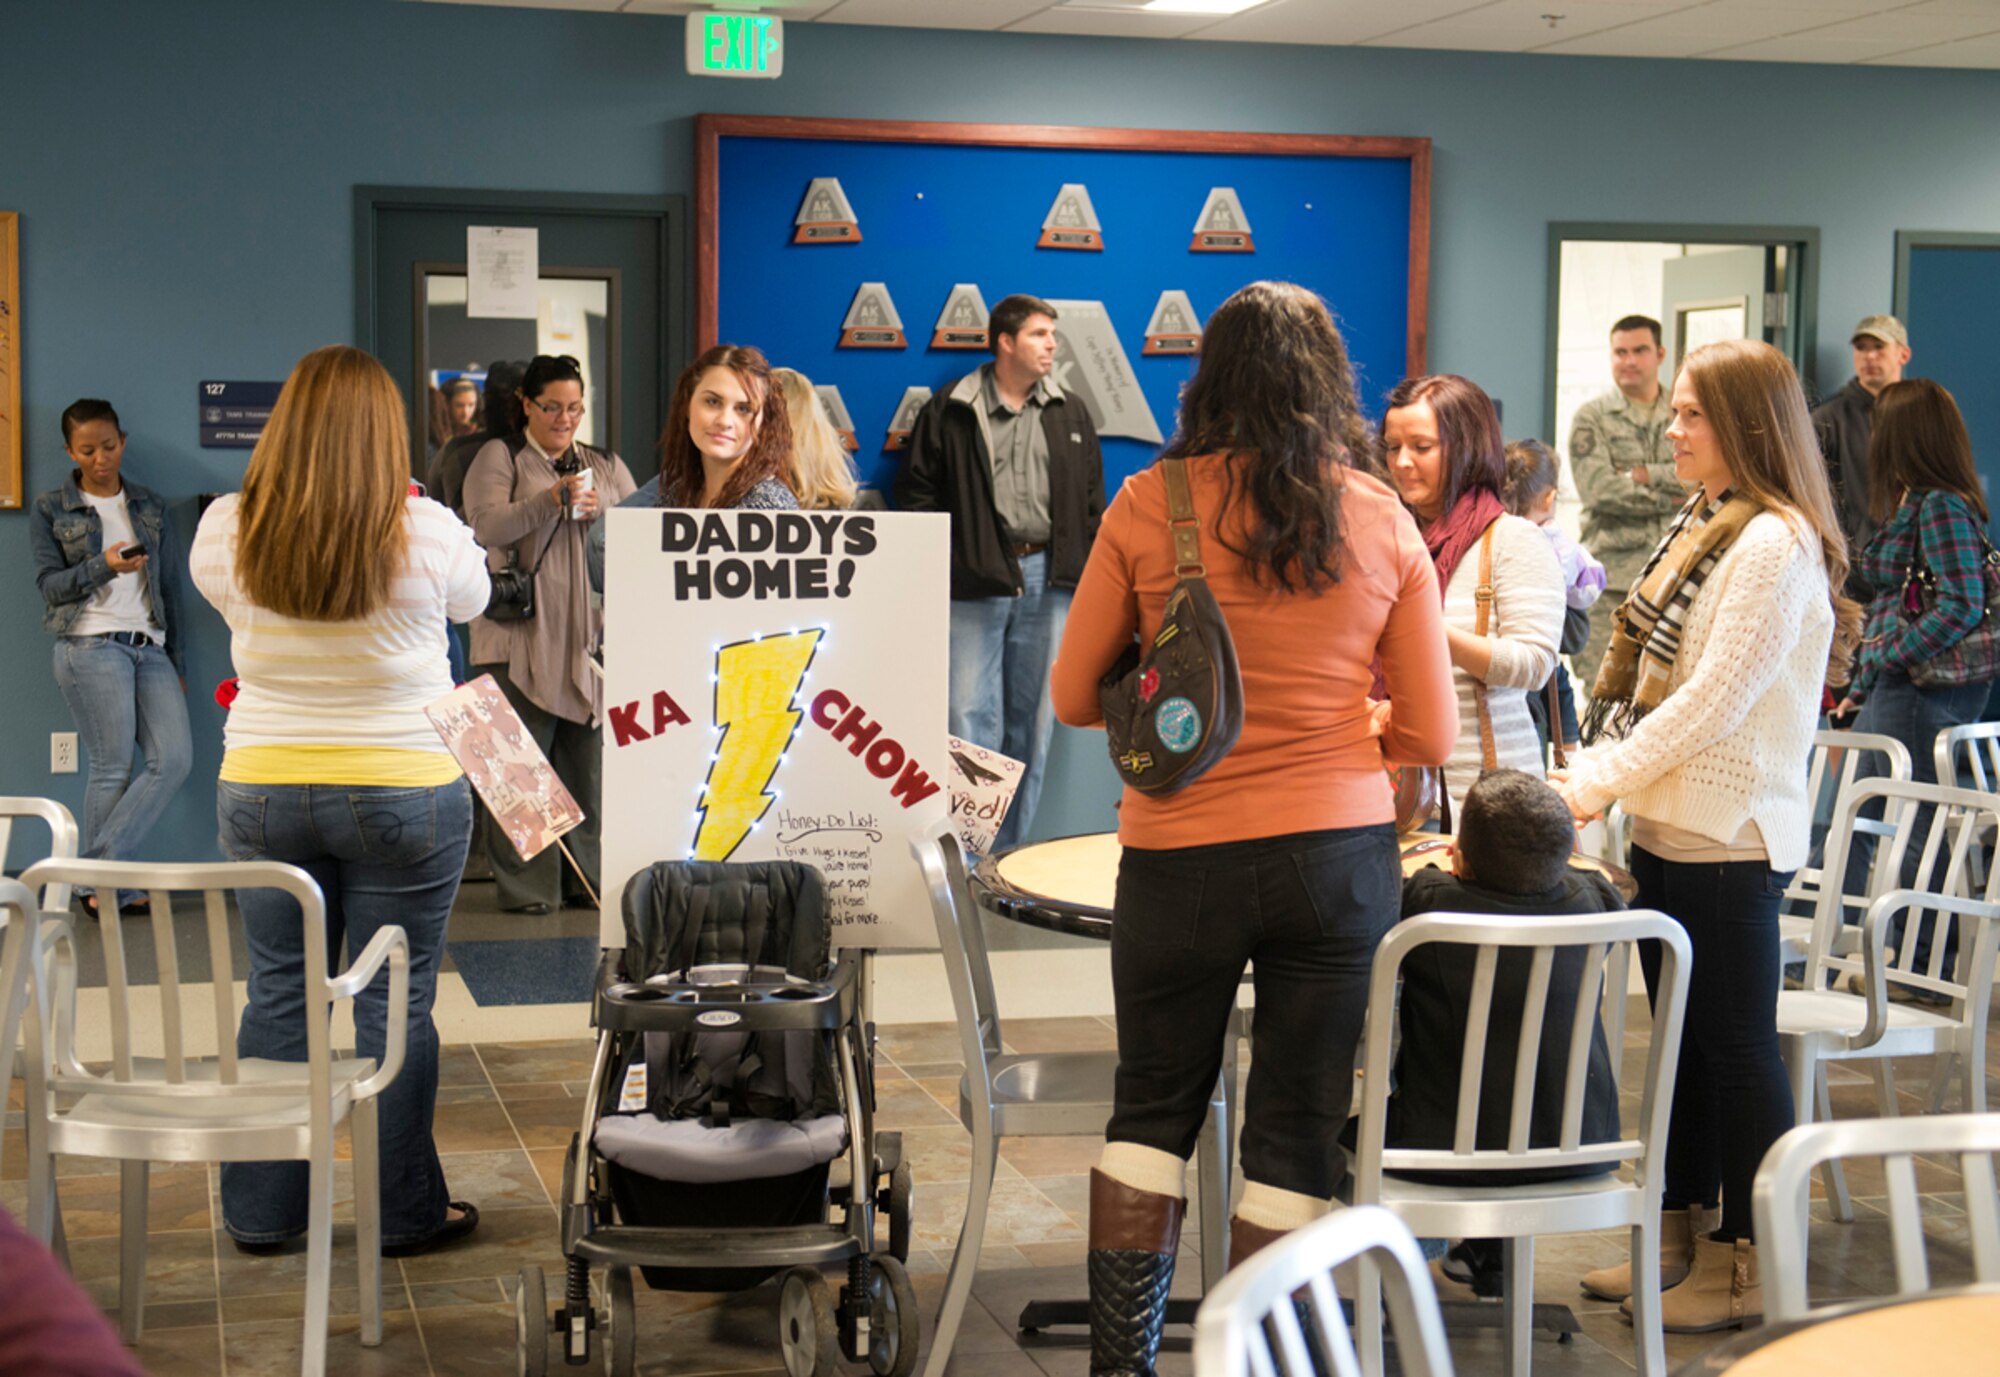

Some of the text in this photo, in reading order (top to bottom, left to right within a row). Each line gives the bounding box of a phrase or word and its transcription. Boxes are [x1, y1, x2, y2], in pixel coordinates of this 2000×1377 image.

[704, 15, 773, 72] EXIT
[813, 200, 830, 212] AK
[1060, 203, 1078, 216] AK
[1213, 210, 1231, 220] AK
[860, 305, 879, 317] AK
[954, 306, 973, 318] AK
[1163, 312, 1181, 323] AK
[205, 383, 226, 395] 127
[661, 512, 877, 556] DADDYS
[673, 558, 856, 601] HOME!
[608, 689, 941, 809] KA CHOW
[485, 775, 523, 813] BEAT
[530, 788, 577, 826] HEAT
[951, 793, 1009, 828] ved!
[784, 845, 809, 857] Give
[844, 910, 855, 925] for
